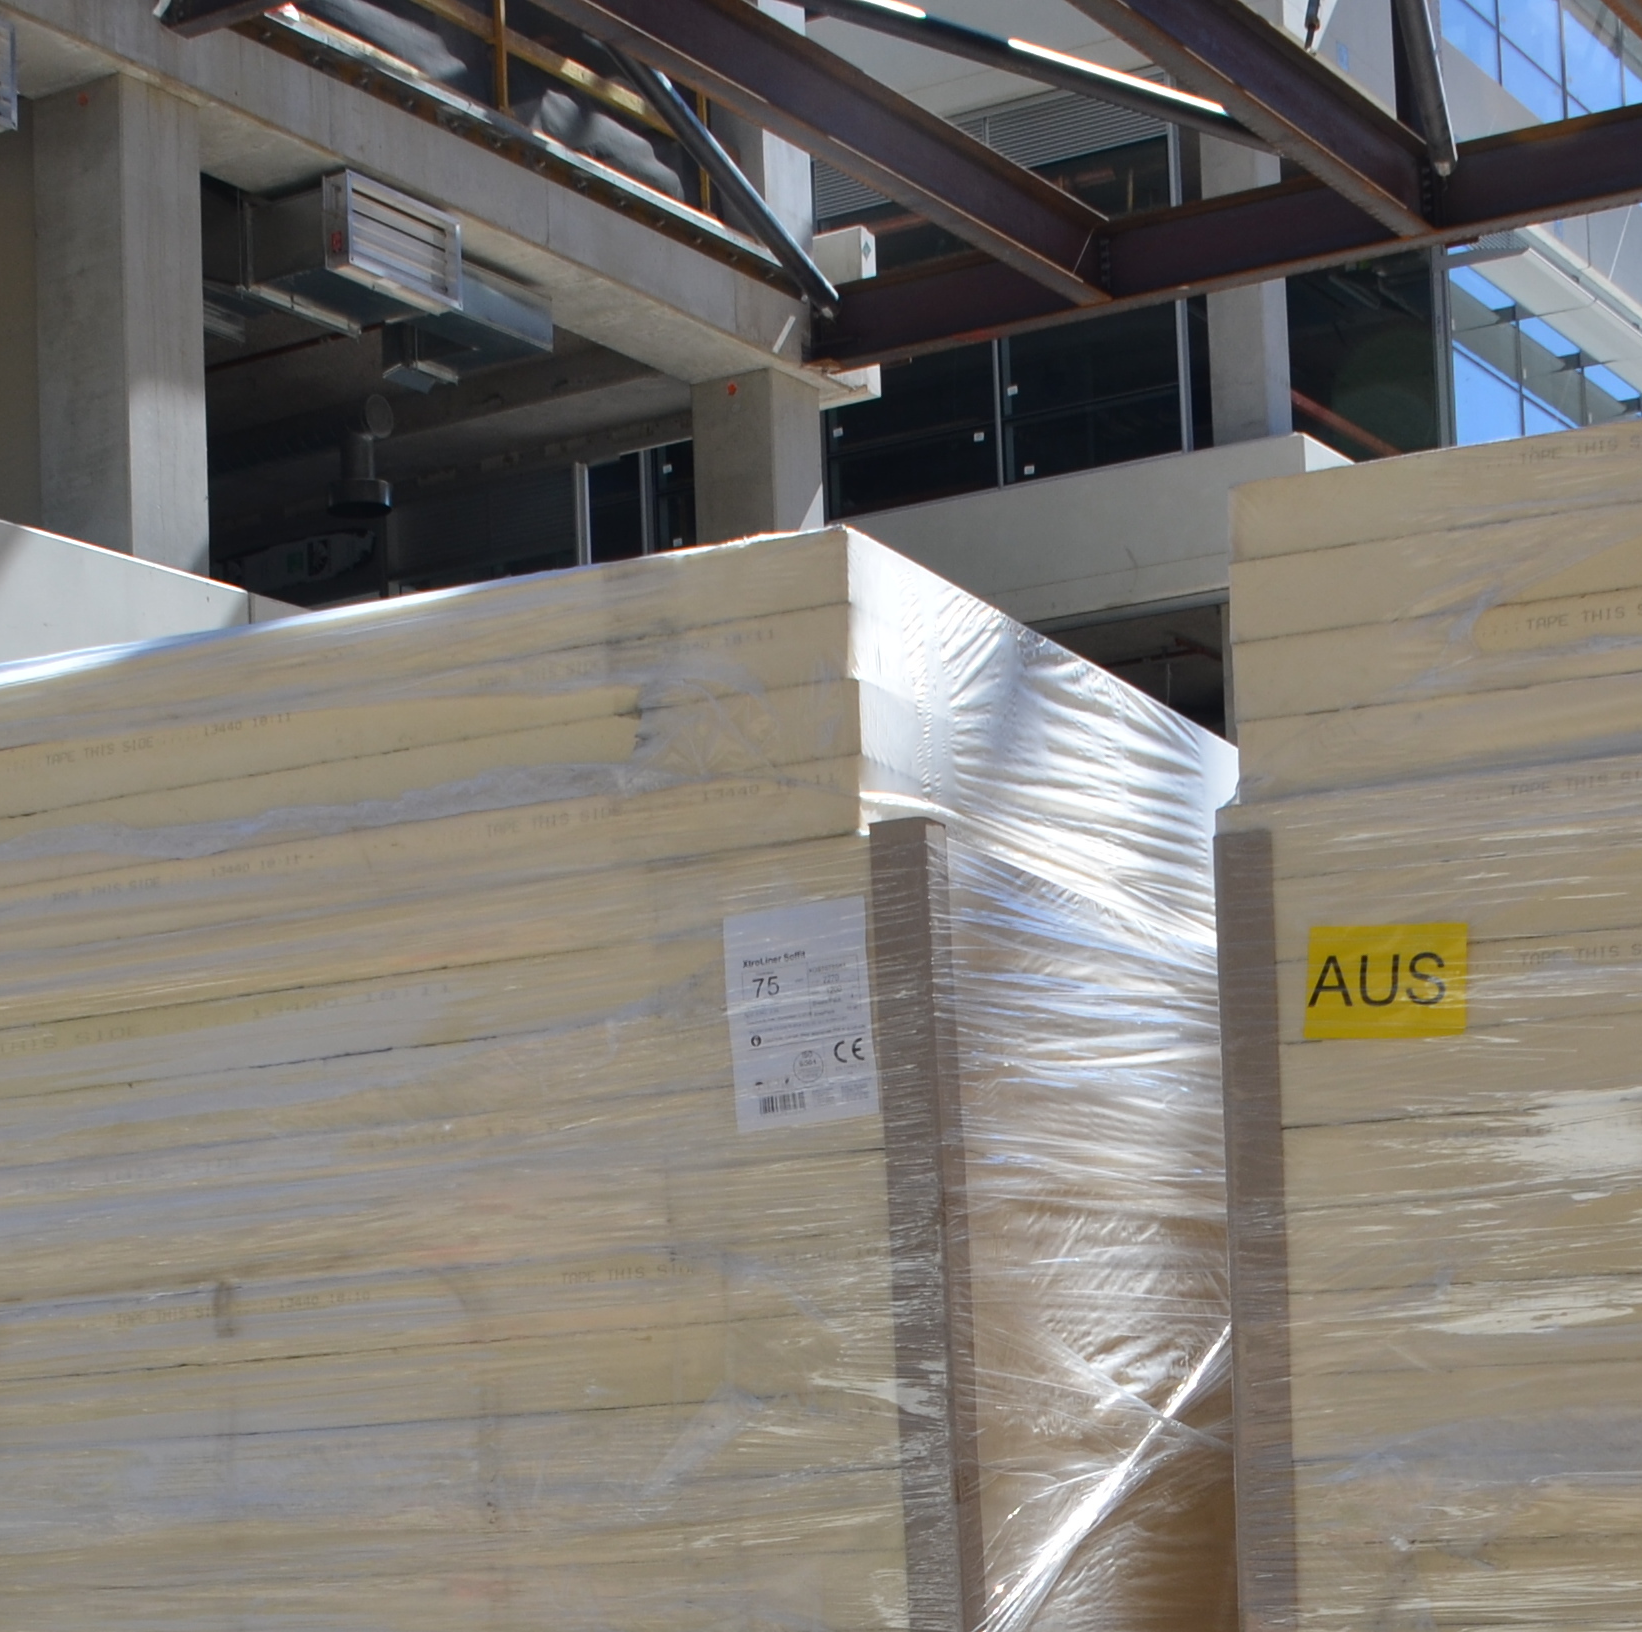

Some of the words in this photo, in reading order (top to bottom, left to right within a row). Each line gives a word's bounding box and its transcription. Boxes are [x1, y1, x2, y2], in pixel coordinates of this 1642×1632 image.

[1525, 614, 1569, 631] TAPE
[1582, 605, 1625, 623] THIS
[45, 750, 76, 766] TAPE
[83, 743, 115, 759] THIS
[122, 736, 154, 753] SIDE
[203, 720, 243, 737] 13440
[252, 712, 292, 728] 18:11
[1509, 780, 1553, 796] TAPE
[91, 882, 122, 897] THIS
[128, 876, 161, 893] SIDE
[742, 954, 782, 969] XtroLiner
[783, 950, 806, 964] Soffit
[1577, 944, 1620, 960] THIS
[752, 975, 780, 999] 75
[1308, 951, 1447, 1008] AUS
[833, 1037, 865, 1064] CE
[560, 1268, 596, 1284] TAPE
[607, 1265, 645, 1281] THIS
